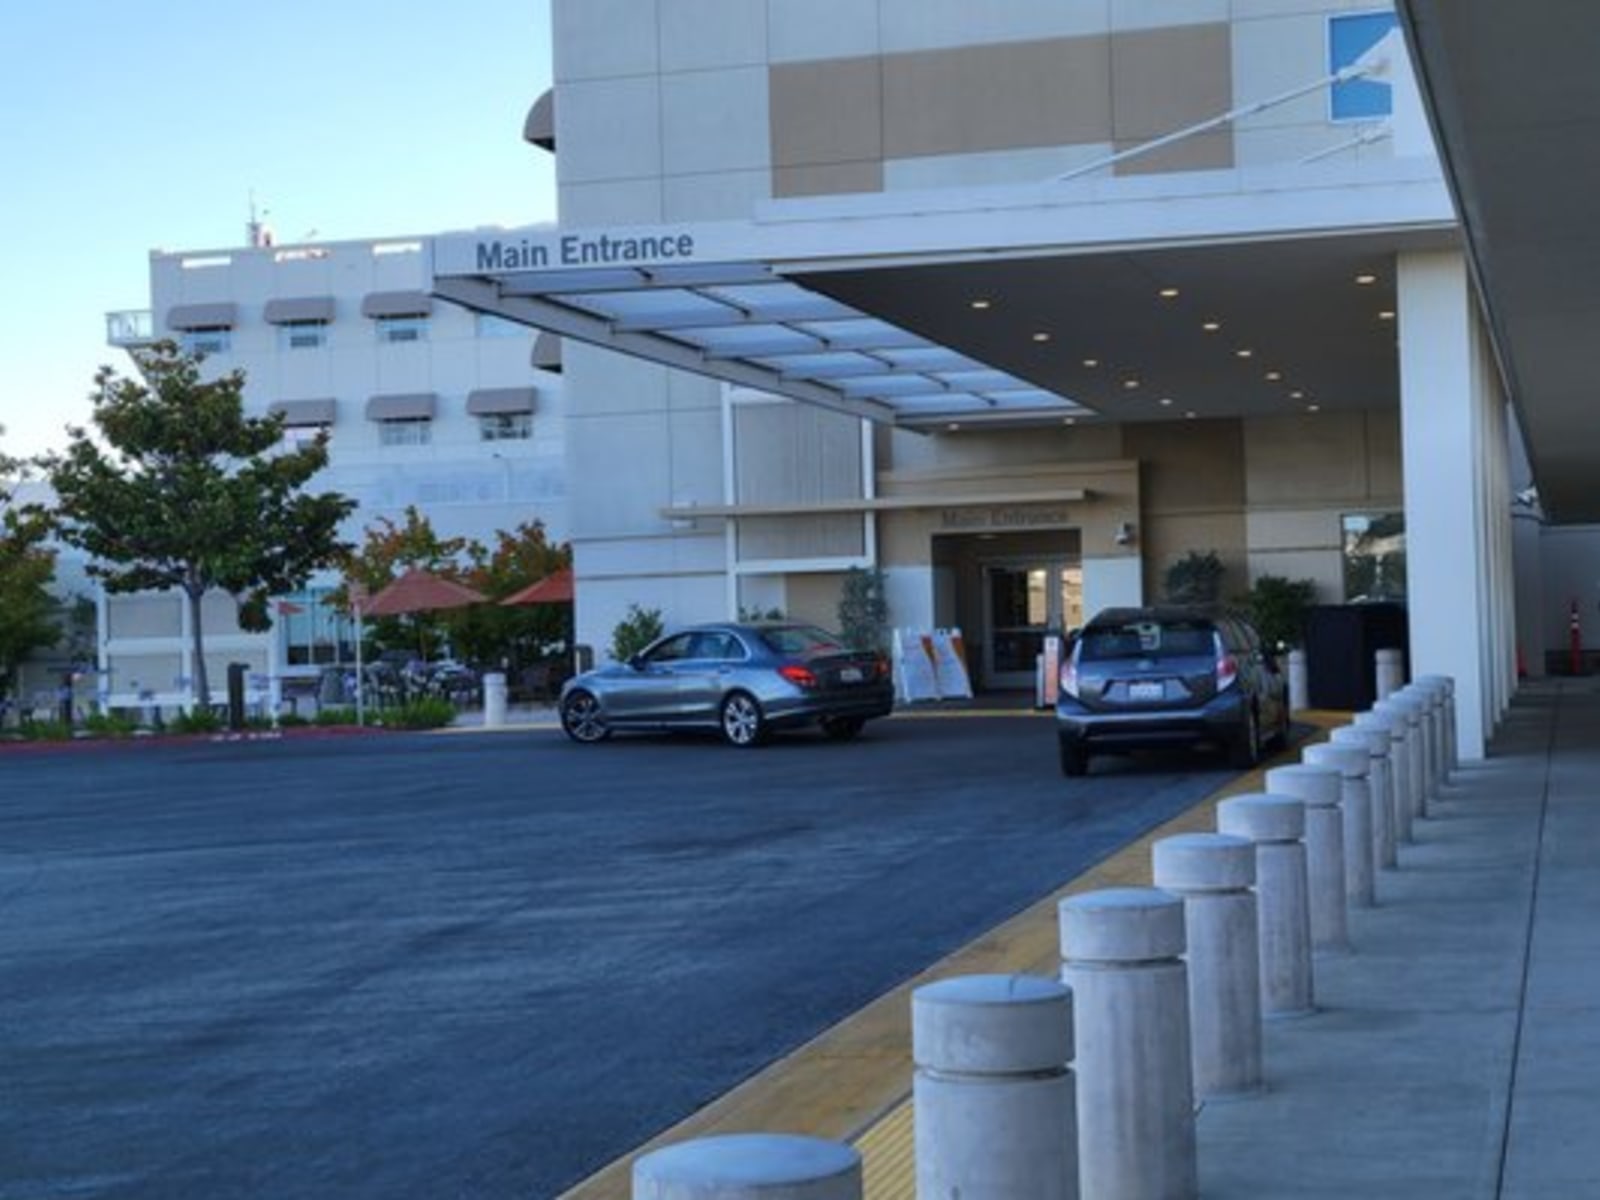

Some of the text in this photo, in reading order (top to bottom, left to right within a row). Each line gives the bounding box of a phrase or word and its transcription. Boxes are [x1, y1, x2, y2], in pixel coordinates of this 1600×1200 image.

[476, 233, 694, 270] Main Entrance
[990, 506, 1069, 526] Entr
